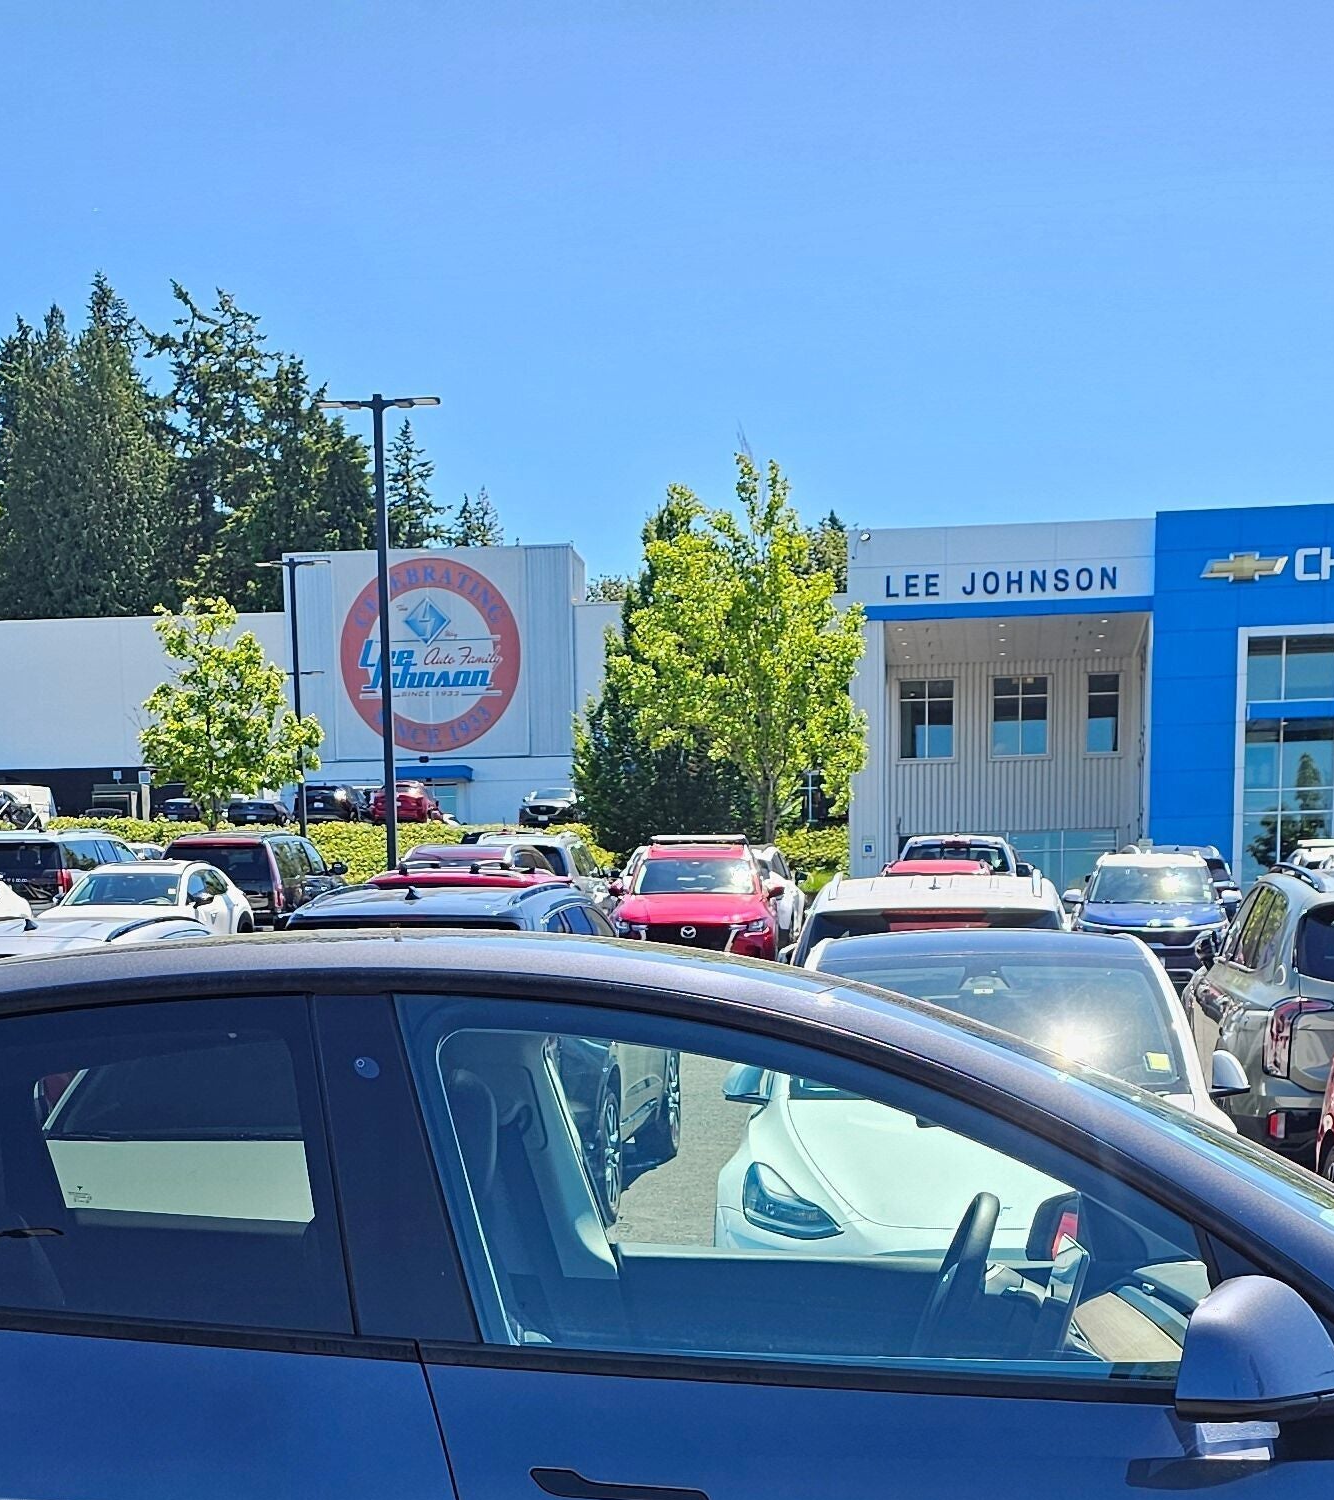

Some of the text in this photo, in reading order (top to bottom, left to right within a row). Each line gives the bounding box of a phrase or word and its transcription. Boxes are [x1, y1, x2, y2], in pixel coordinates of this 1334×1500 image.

[354, 566, 503, 628] CEEBRATING
[885, 566, 1118, 598] LEE JOHNSON
[423, 647, 455, 665] Auto
[458, 646, 503, 669] Family
